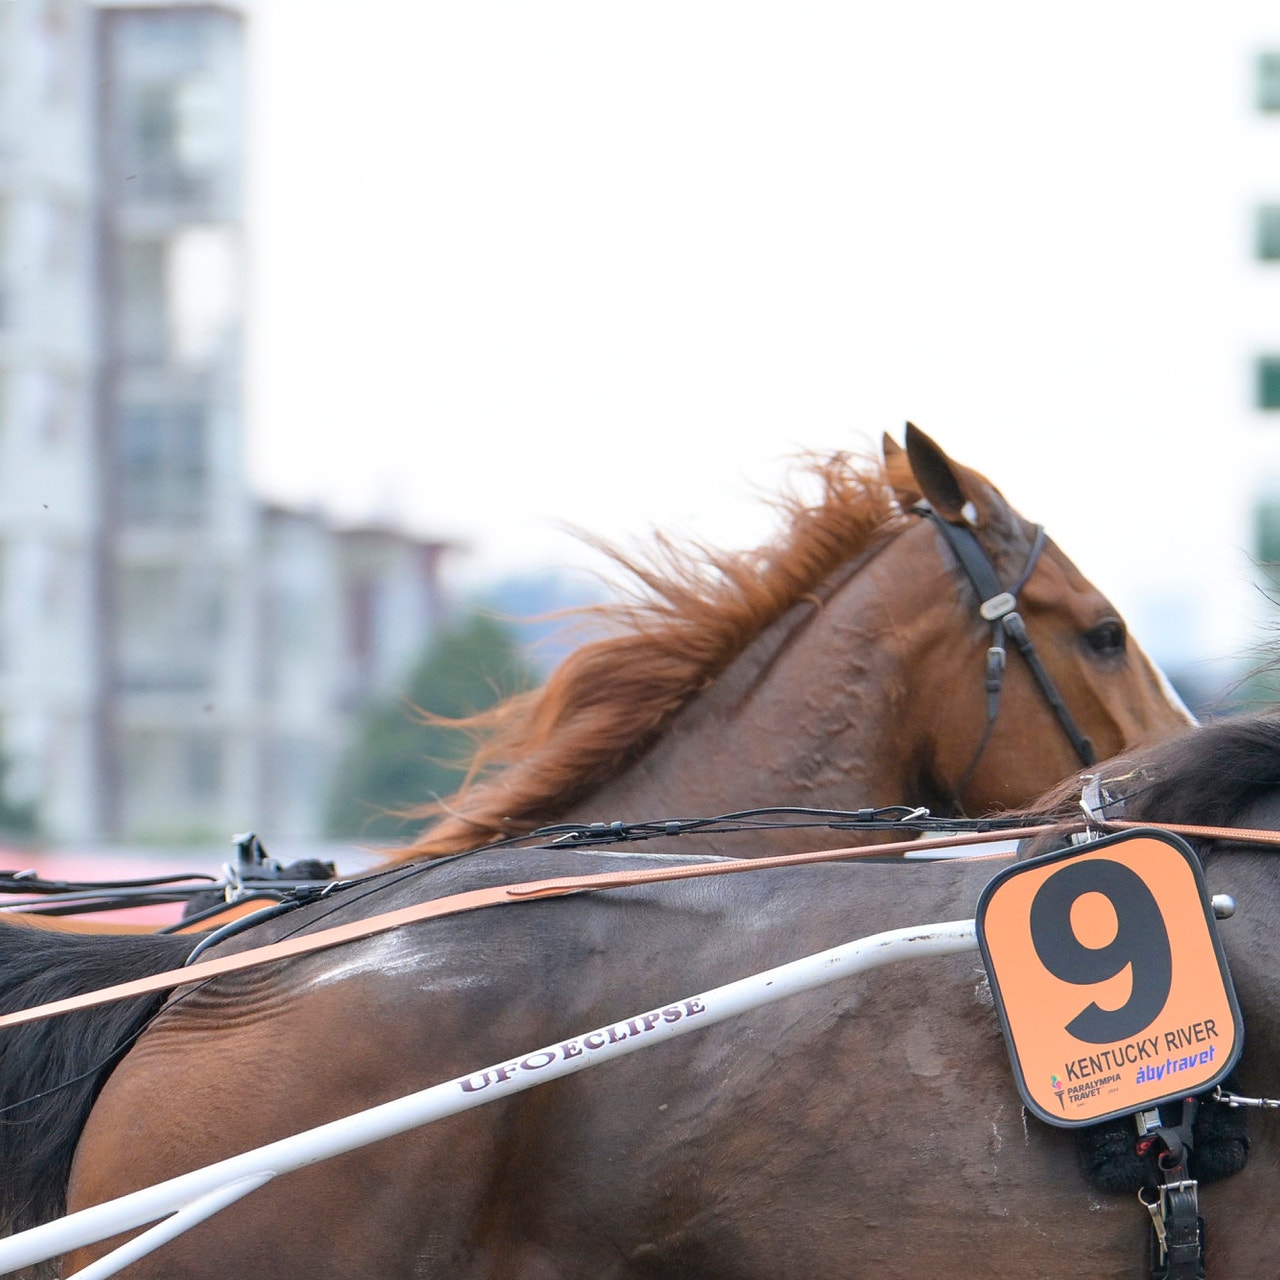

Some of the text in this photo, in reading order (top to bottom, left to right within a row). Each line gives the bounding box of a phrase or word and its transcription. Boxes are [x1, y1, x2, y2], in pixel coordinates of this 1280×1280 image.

[1030, 858, 1173, 1044] 9
[457, 997, 707, 1092] UFO ECLIPSE
[1064, 1018, 1219, 1082] KENTUCKY RIVER
[1066, 1073, 1122, 1096] PARALYMPIA
[1068, 1087, 1101, 1104] TRAVET
